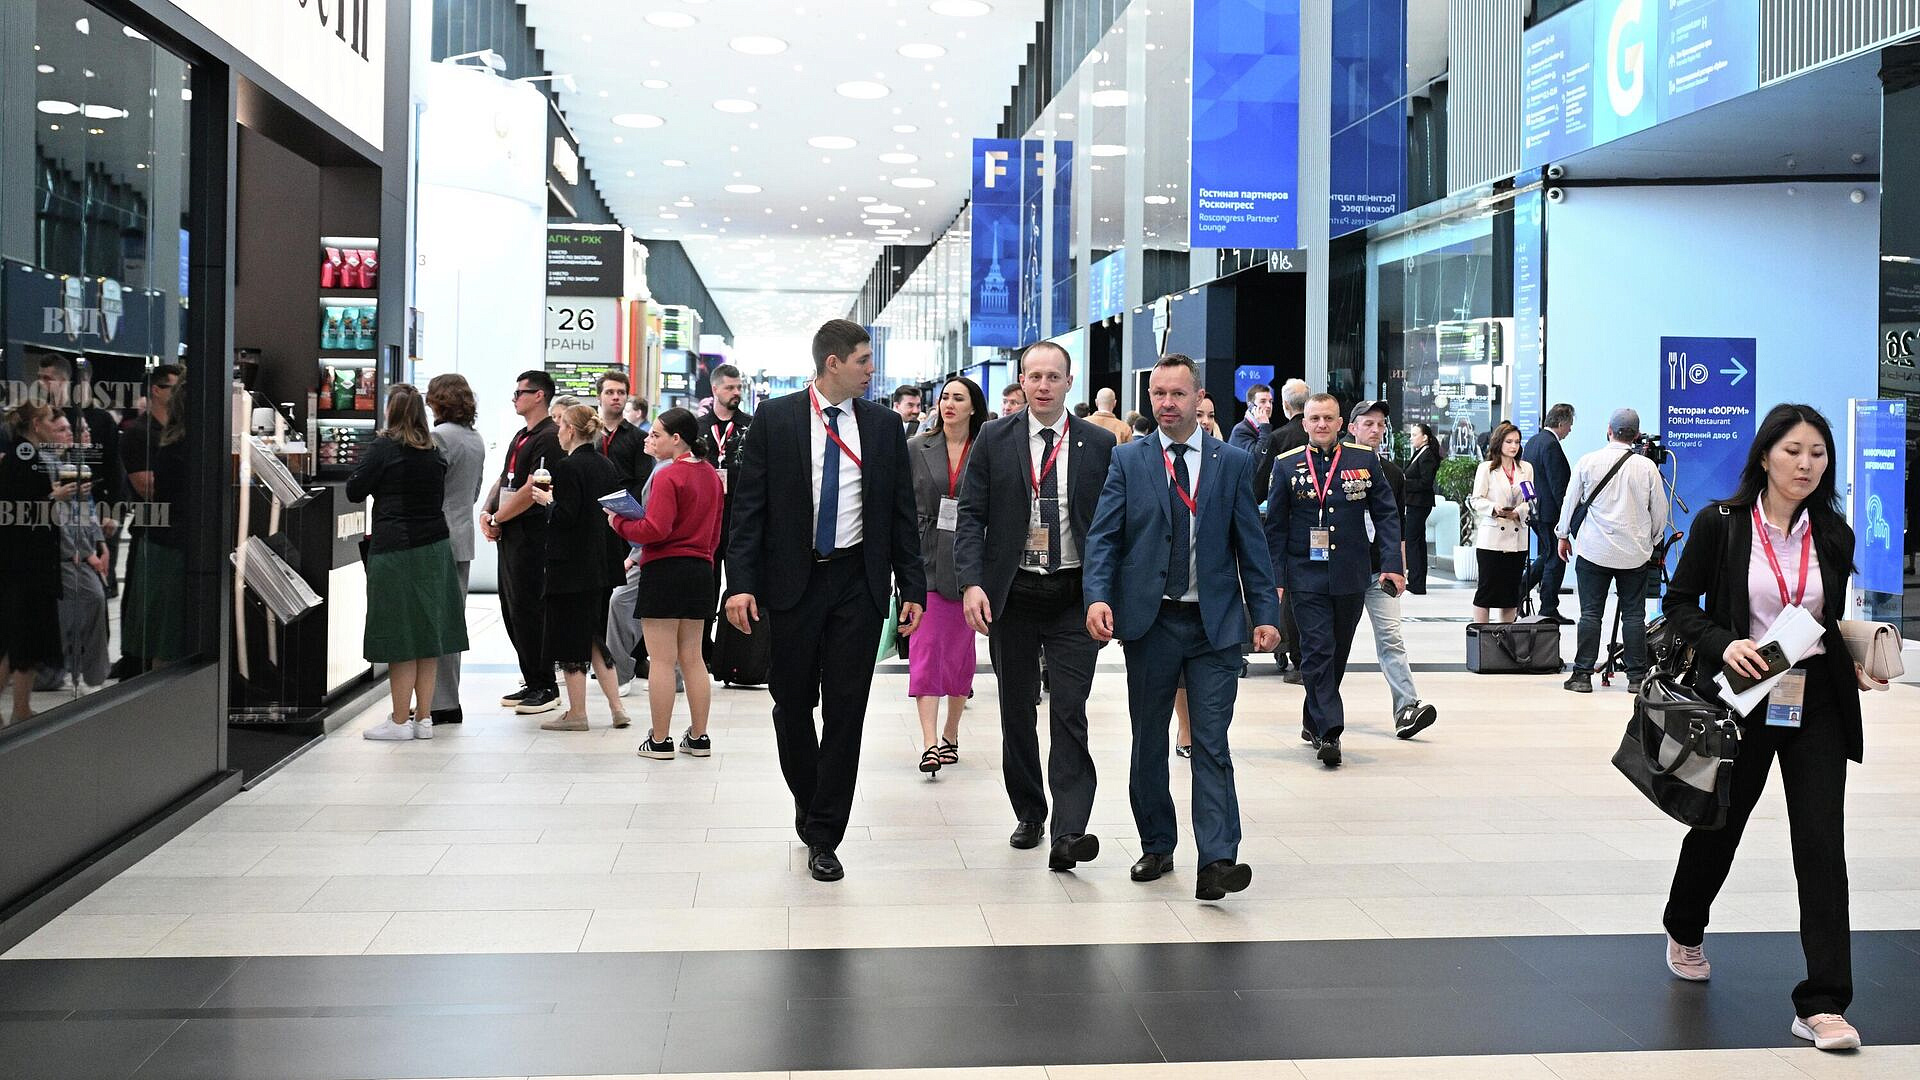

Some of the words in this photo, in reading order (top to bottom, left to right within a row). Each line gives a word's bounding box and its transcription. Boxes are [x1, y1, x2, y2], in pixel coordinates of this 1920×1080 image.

[1607, 0, 1645, 117] G
[984, 151, 1009, 188] F
[1199, 188, 1240, 199] Гостиная
[1241, 191, 1289, 201] партнеров
[1199, 199, 1255, 211] Росконгресс
[1199, 213, 1245, 223] Roscongress
[1246, 214, 1279, 223] Partners'
[1199, 223, 1227, 232] Lounge
[548, 235, 571, 244] АПК
[581, 235, 602, 244] РХК
[1668, 405, 1707, 416] Ресторан
[1708, 405, 1750, 416] «ФОРУМ»
[1668, 417, 1694, 425] FORUM
[1695, 417, 1731, 425] Restaurant
[1668, 431, 1712, 440] Внутренний
[1712, 432, 1731, 440] двор
[1732, 431, 1738, 439] G
[1668, 440, 1697, 448] Courtyard
[1402, 710, 1413, 720] N
